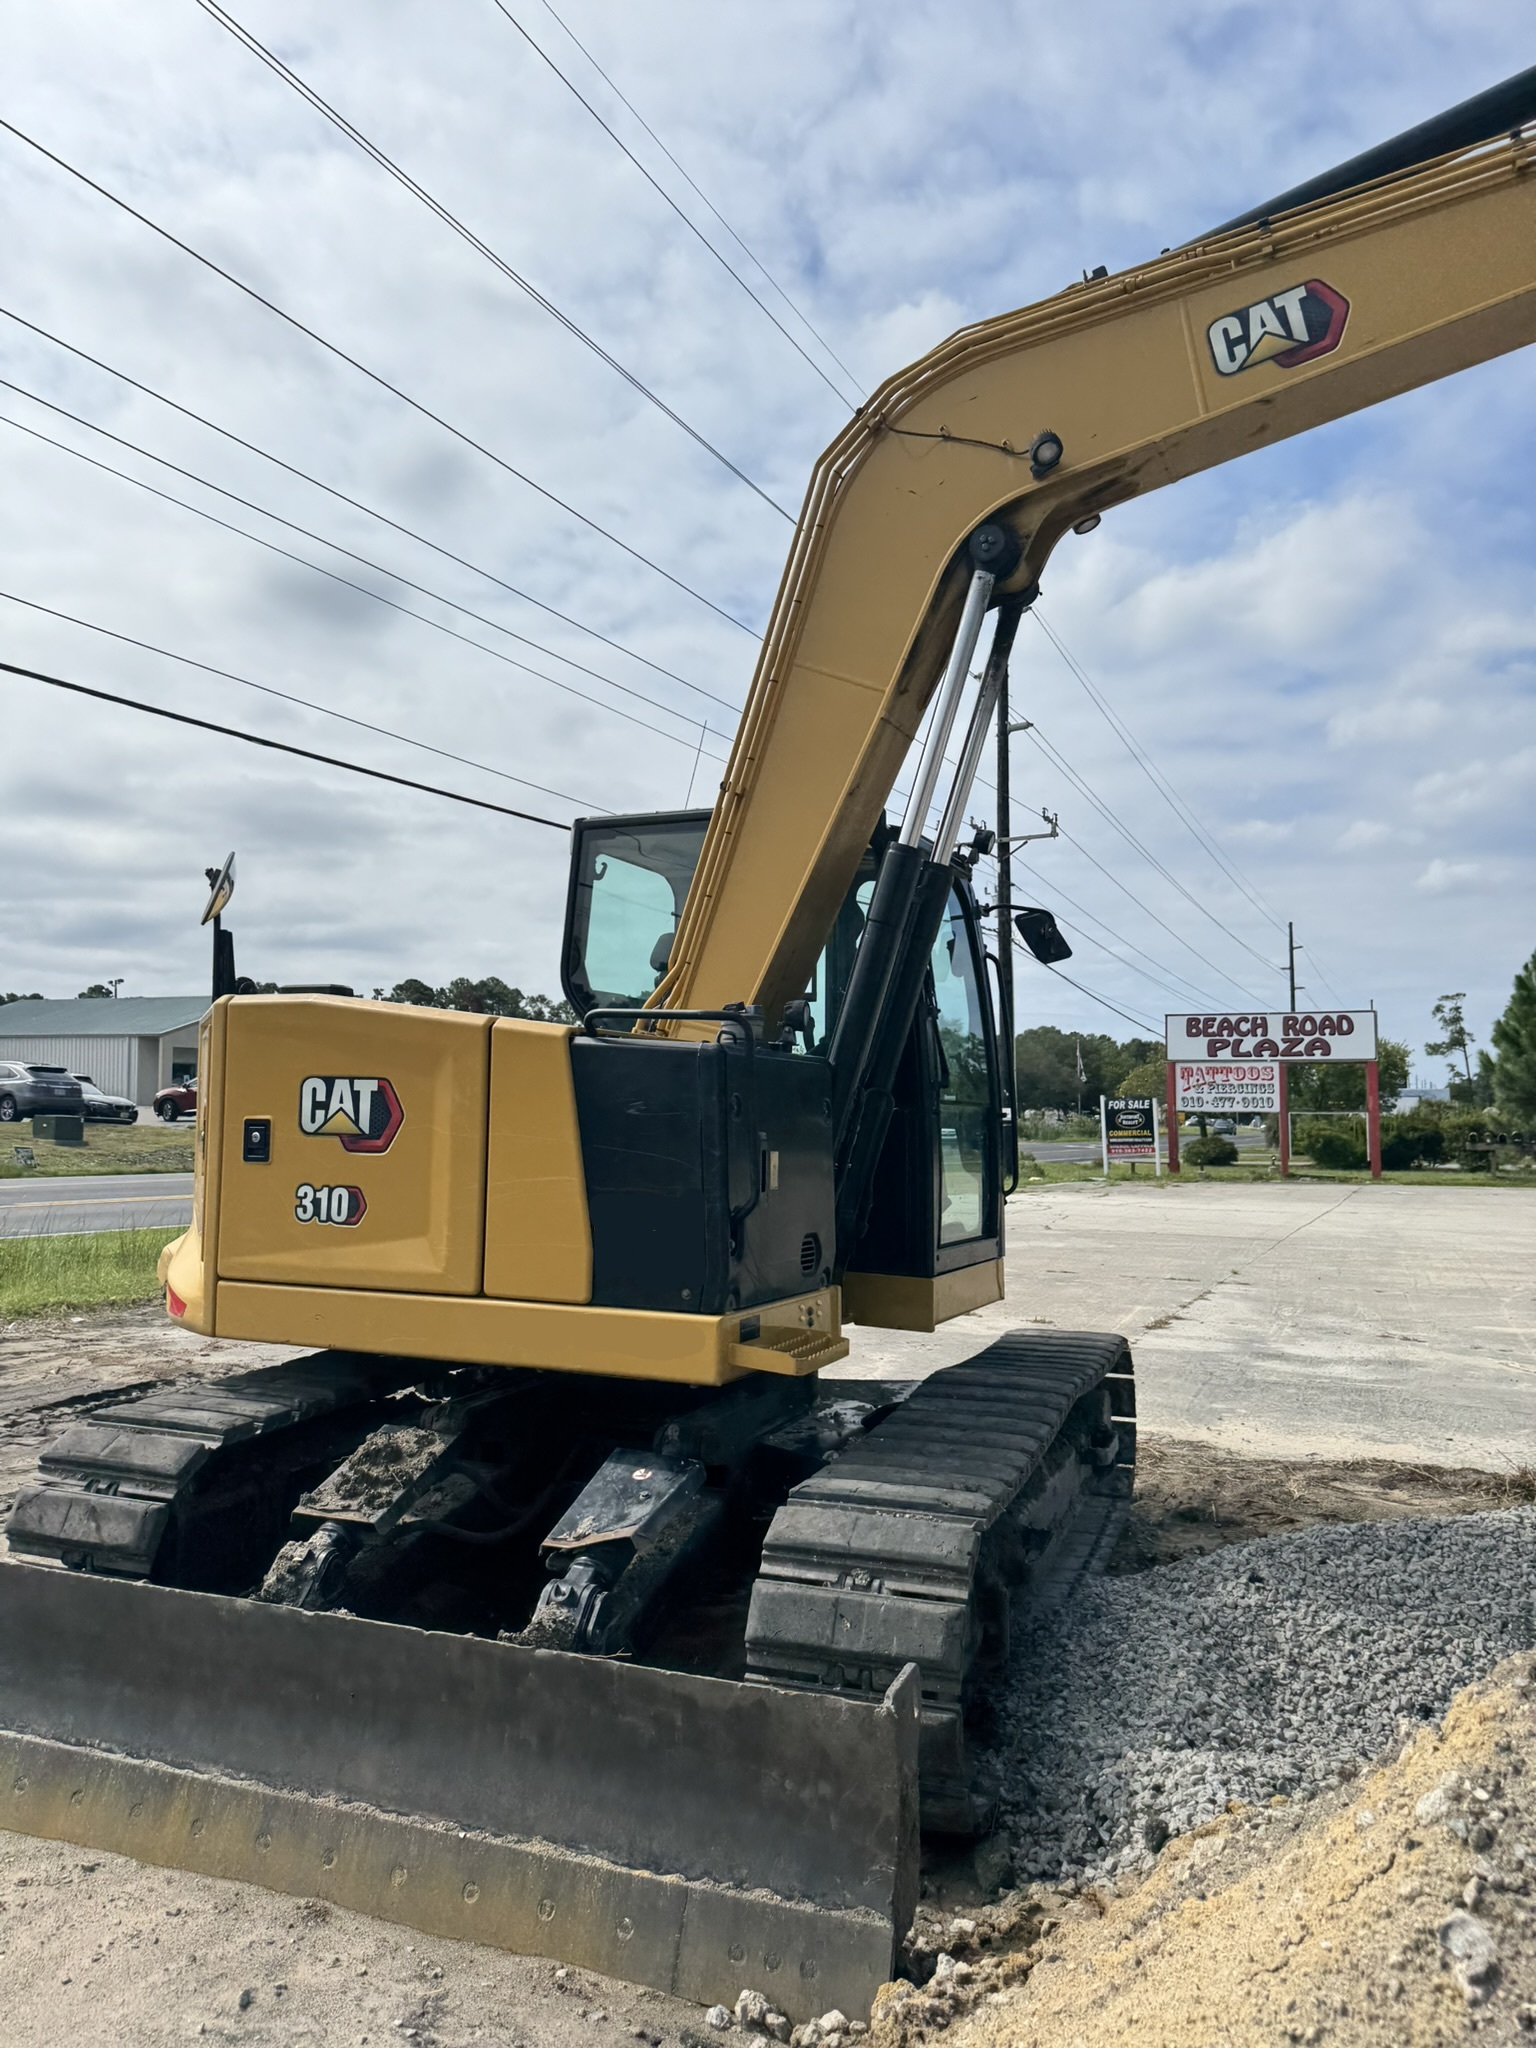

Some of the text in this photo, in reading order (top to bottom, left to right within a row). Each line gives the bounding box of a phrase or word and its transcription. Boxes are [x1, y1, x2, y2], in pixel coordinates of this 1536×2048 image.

[1209, 285, 1310, 374] CAT
[1186, 1015, 1354, 1037] BEACH ROAD
[1207, 1037, 1332, 1057] PLAZA
[1180, 1066, 1275, 1092] TATTOOS
[1195, 1083, 1275, 1094] & PIERCINGS
[301, 1077, 378, 1134] CAT
[1108, 1100, 1150, 1110] FOR SALE
[296, 1184, 350, 1223] 310
